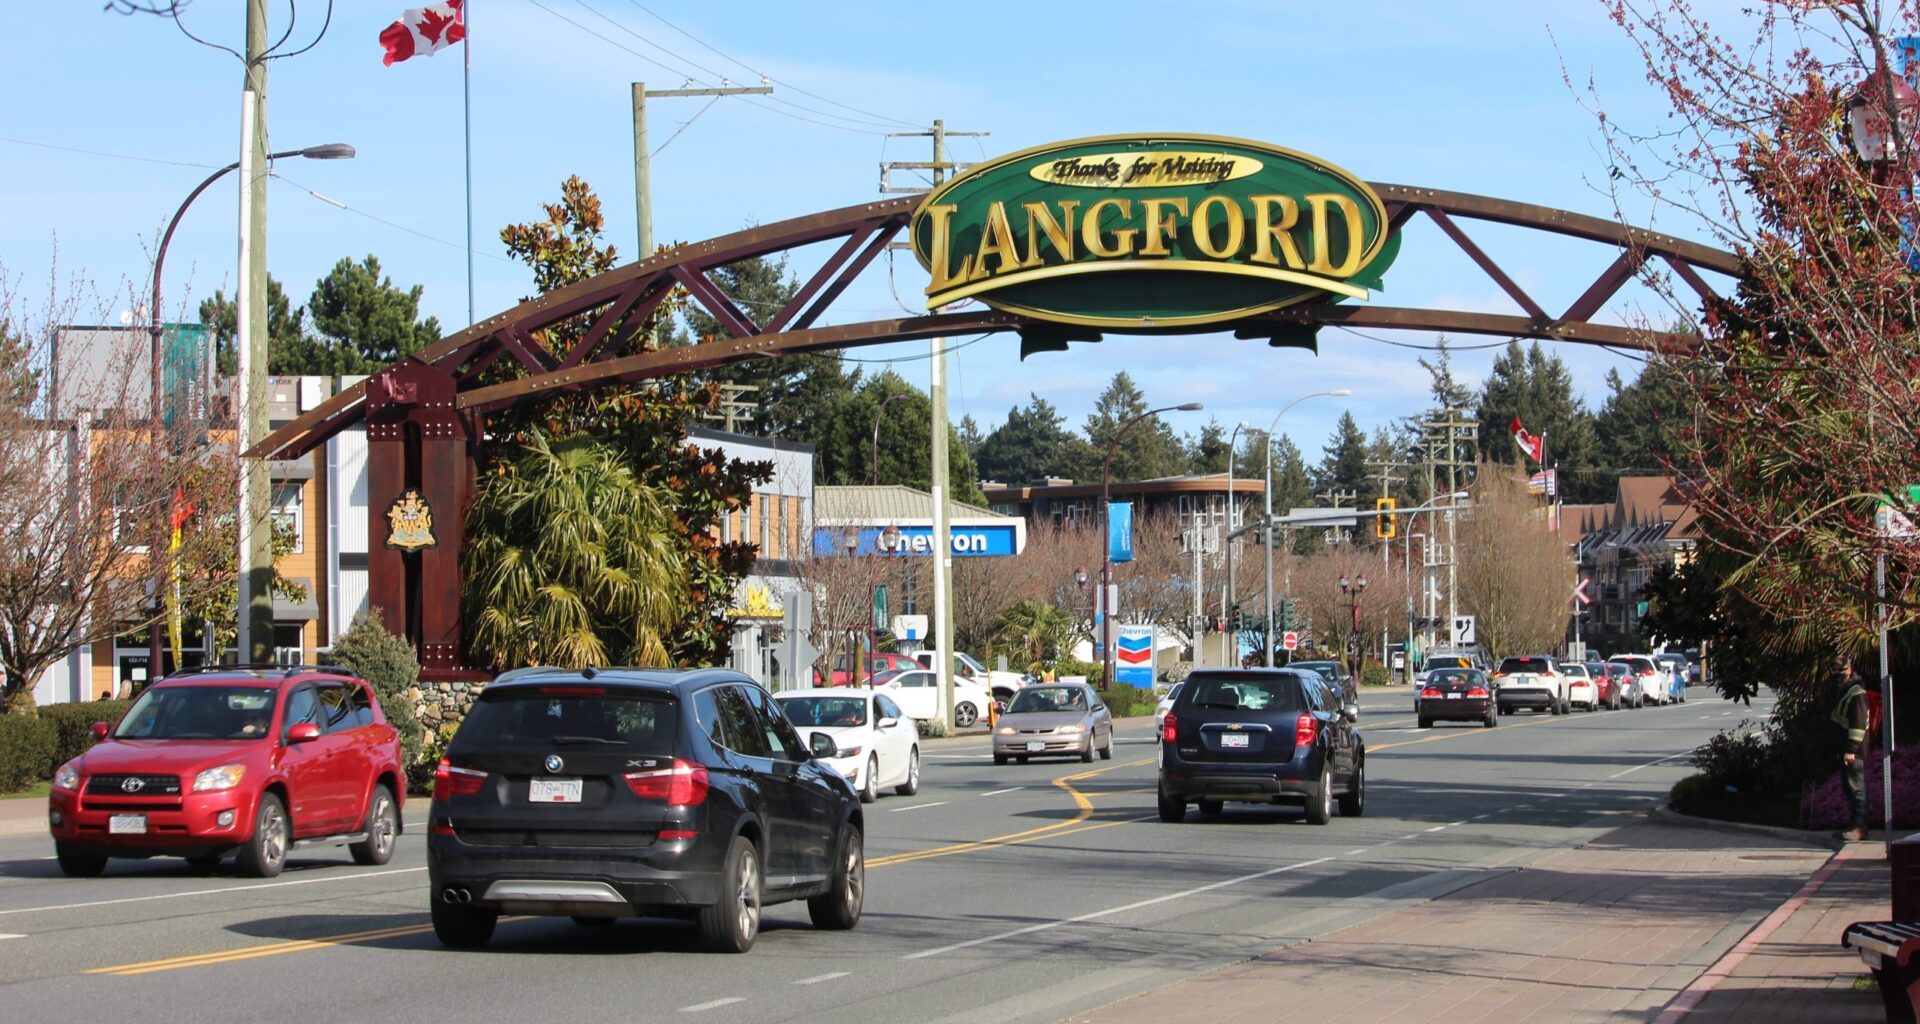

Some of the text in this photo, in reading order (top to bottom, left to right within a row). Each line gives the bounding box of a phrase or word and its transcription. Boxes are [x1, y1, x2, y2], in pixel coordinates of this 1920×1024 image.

[1053, 155, 1236, 183] Thanks for Visiting
[925, 193, 1365, 296] LANGFORD
[625, 759, 657, 767] X3
